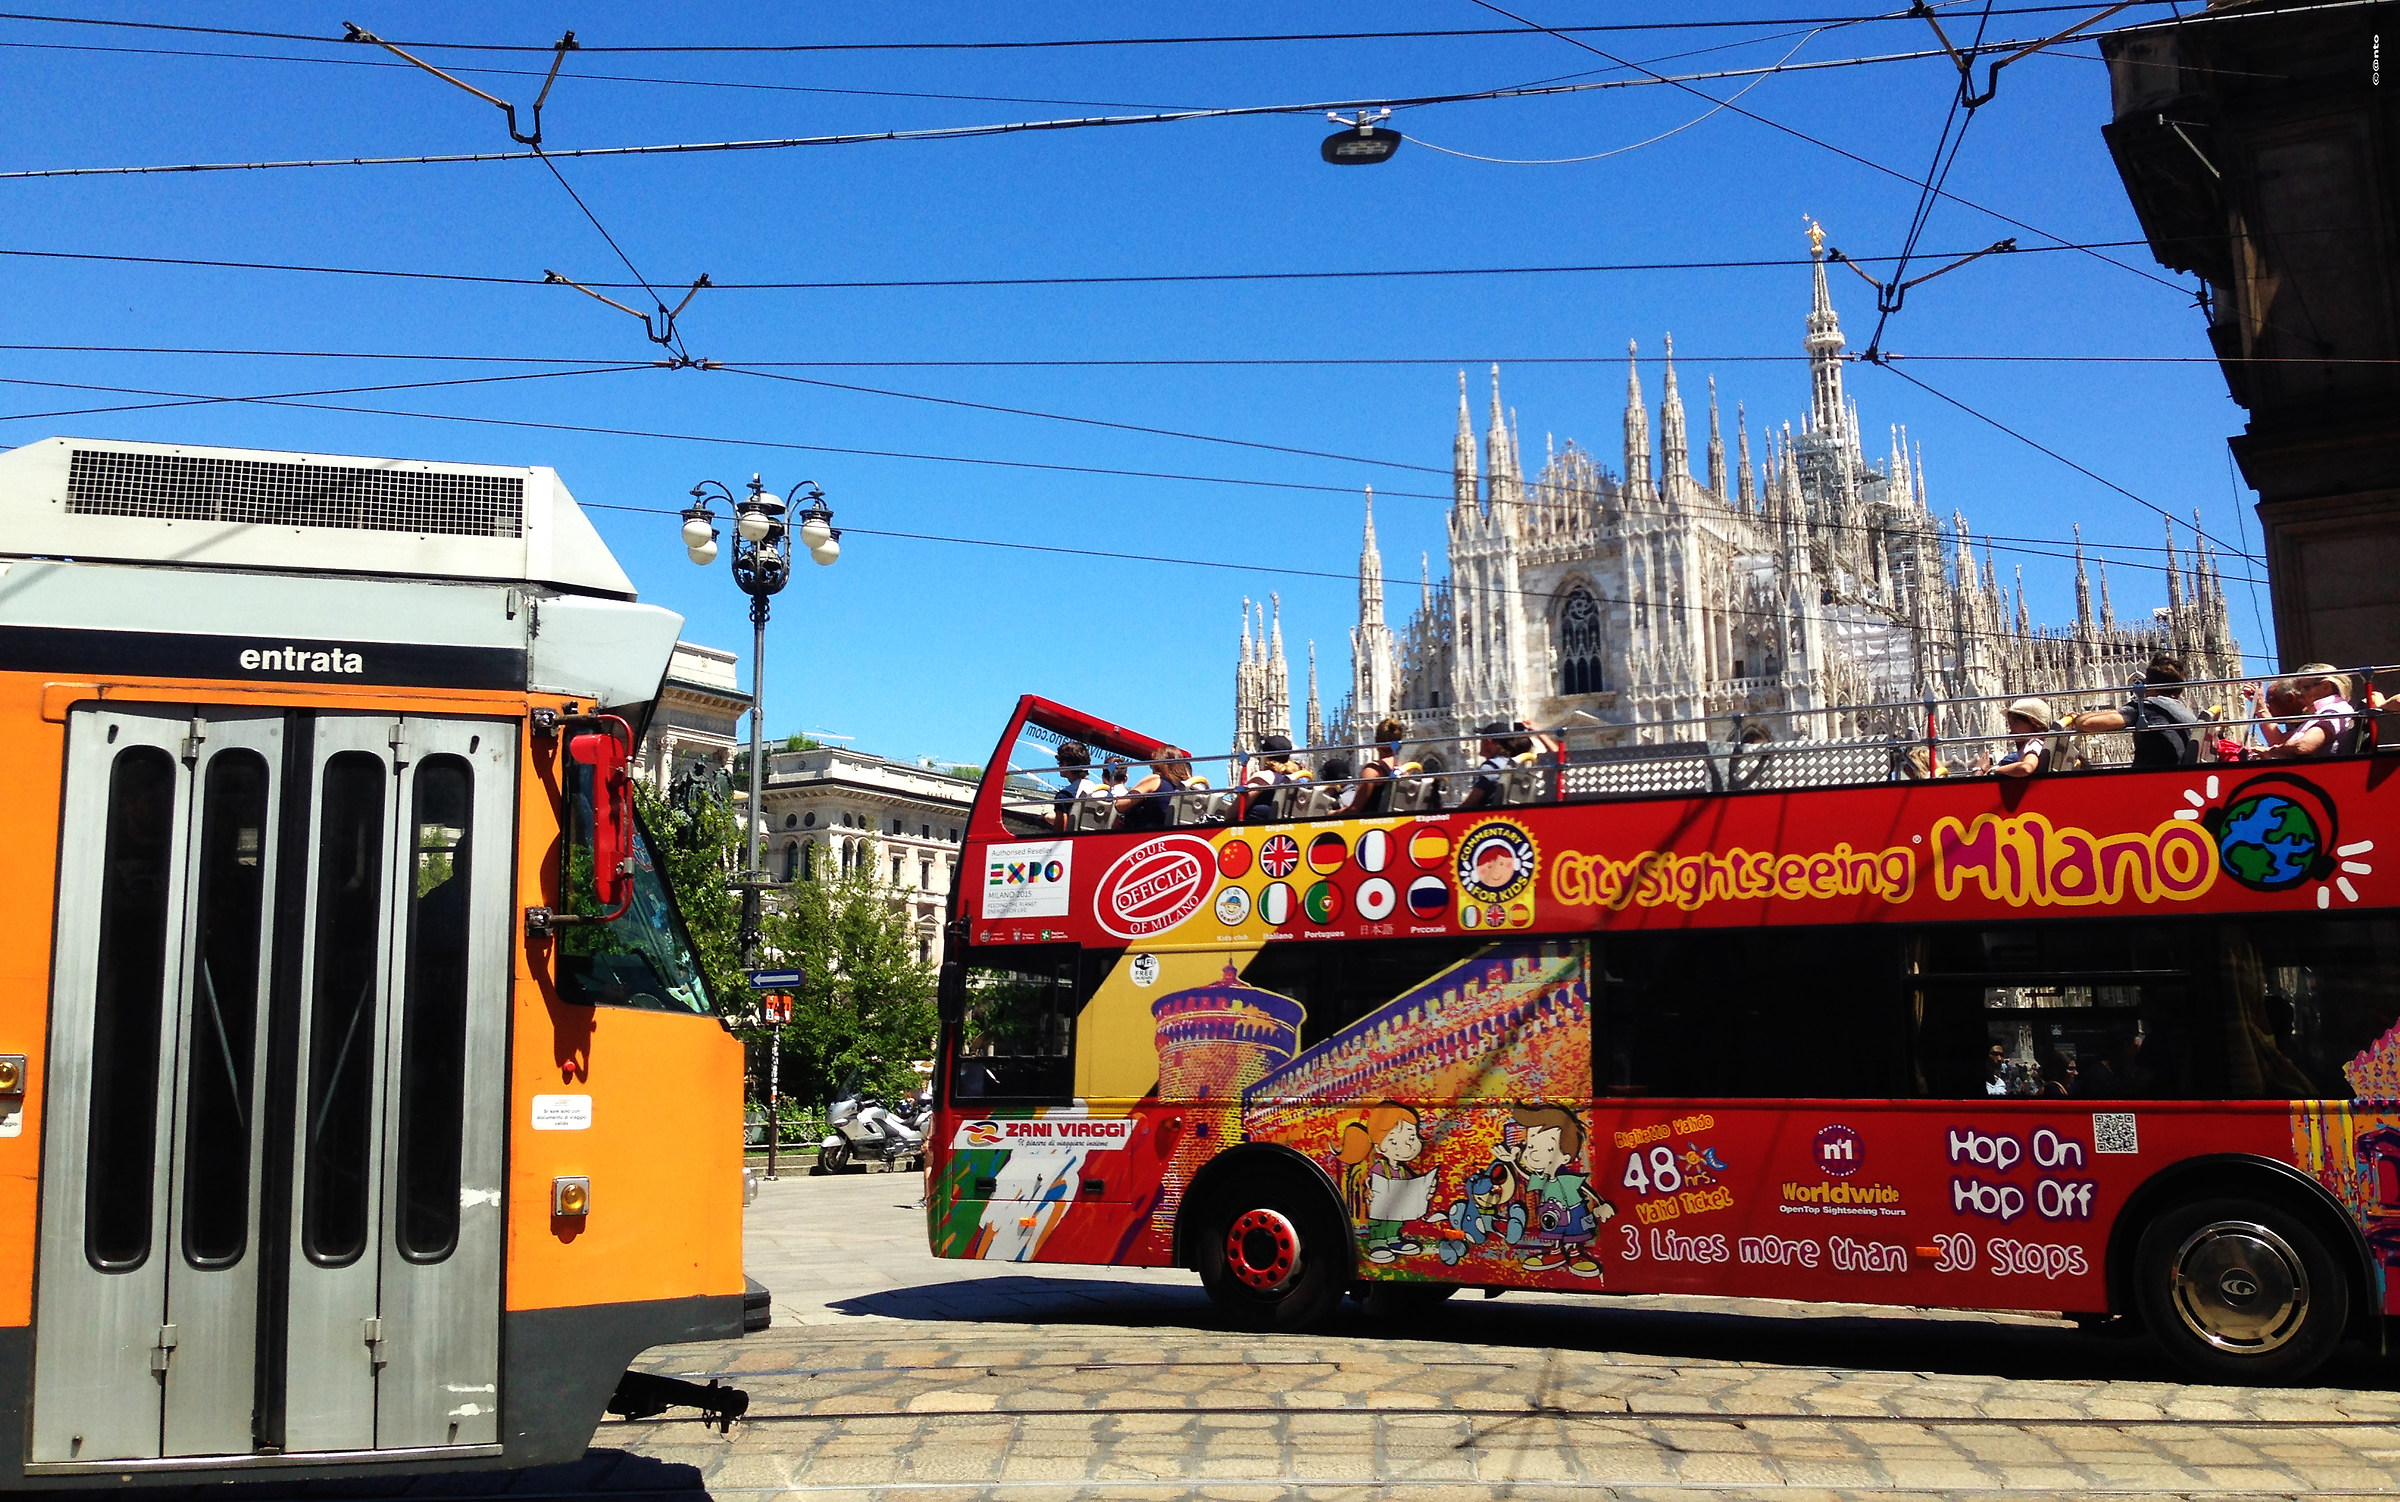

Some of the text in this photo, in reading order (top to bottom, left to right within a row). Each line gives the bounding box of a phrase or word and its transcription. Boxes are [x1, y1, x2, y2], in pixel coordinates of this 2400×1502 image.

[240, 646, 363, 674] entrata
[1126, 842, 1167, 866] TOUR
[1461, 827, 1522, 861] COMMENTARY
[1930, 812, 2217, 907] Milano
[989, 860, 1064, 885] EXPO
[1117, 863, 1197, 909] OFFICIAL
[1472, 876, 1528, 902] FOR KIDS
[988, 890, 1032, 899] MILANO 2015
[1130, 922, 1148, 934] OF
[1151, 895, 1199, 931] MILANO
[1005, 1123, 1125, 1137] ZANI VIAGGI
[1025, 1139, 1046, 1147] piacere
[1048, 1138, 1055, 1146] di
[1056, 1139, 1085, 1148] viaggiare
[1086, 1138, 1108, 1147] insieme
[1614, 1114, 1714, 1148] Biglietto Valido
[1950, 1129, 2082, 1170] Hop On
[1623, 1146, 1681, 1194] 48
[1635, 1186, 1734, 1225] Valid Ticket
[1782, 1181, 1900, 1204] Worldwide
[1954, 1179, 2093, 1220] Hop Off
[1822, 1205, 1878, 1217] Sightseeing
[1879, 1207, 1907, 1216] Tours
[1620, 1224, 2089, 1280] 3 Lines more than 30 Stops
